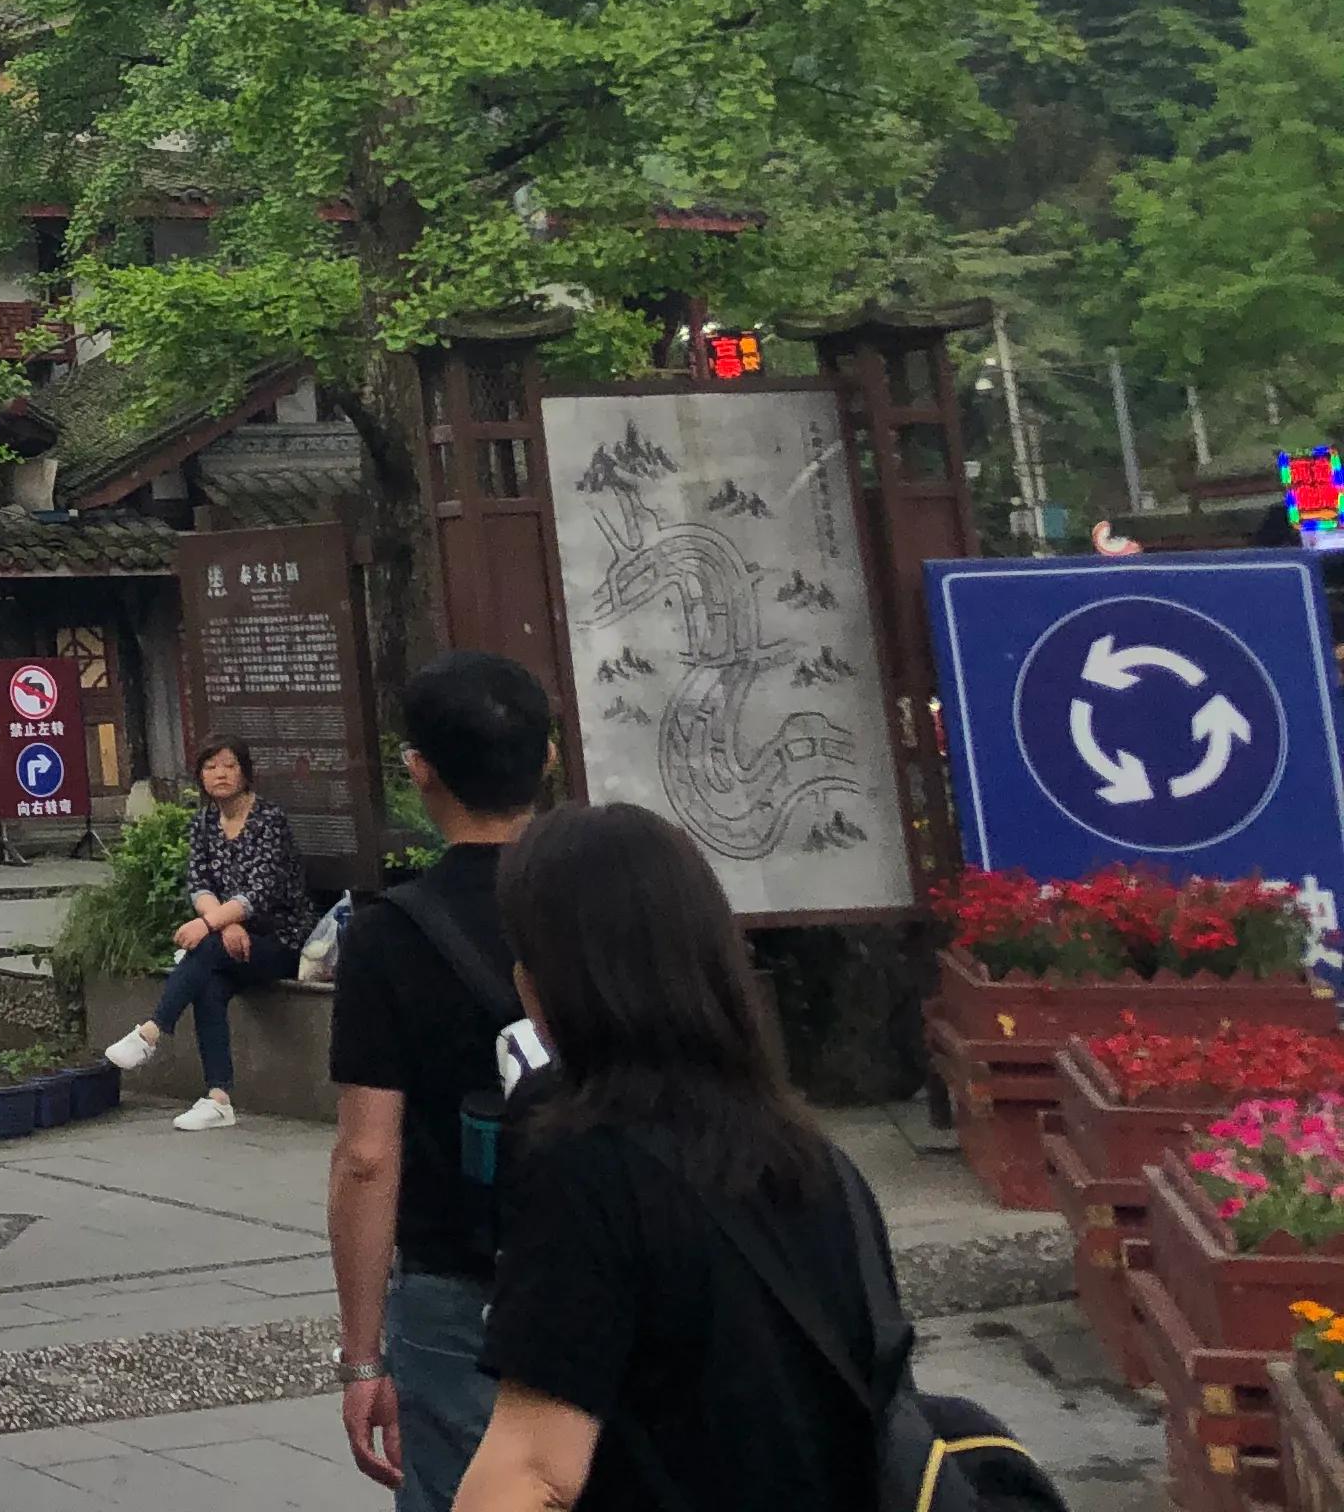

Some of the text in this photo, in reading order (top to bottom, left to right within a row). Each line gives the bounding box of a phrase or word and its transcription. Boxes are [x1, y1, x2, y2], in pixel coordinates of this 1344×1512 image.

[9, 720, 64, 738] 禁止左转
[17, 798, 72, 817] 向右转弯
